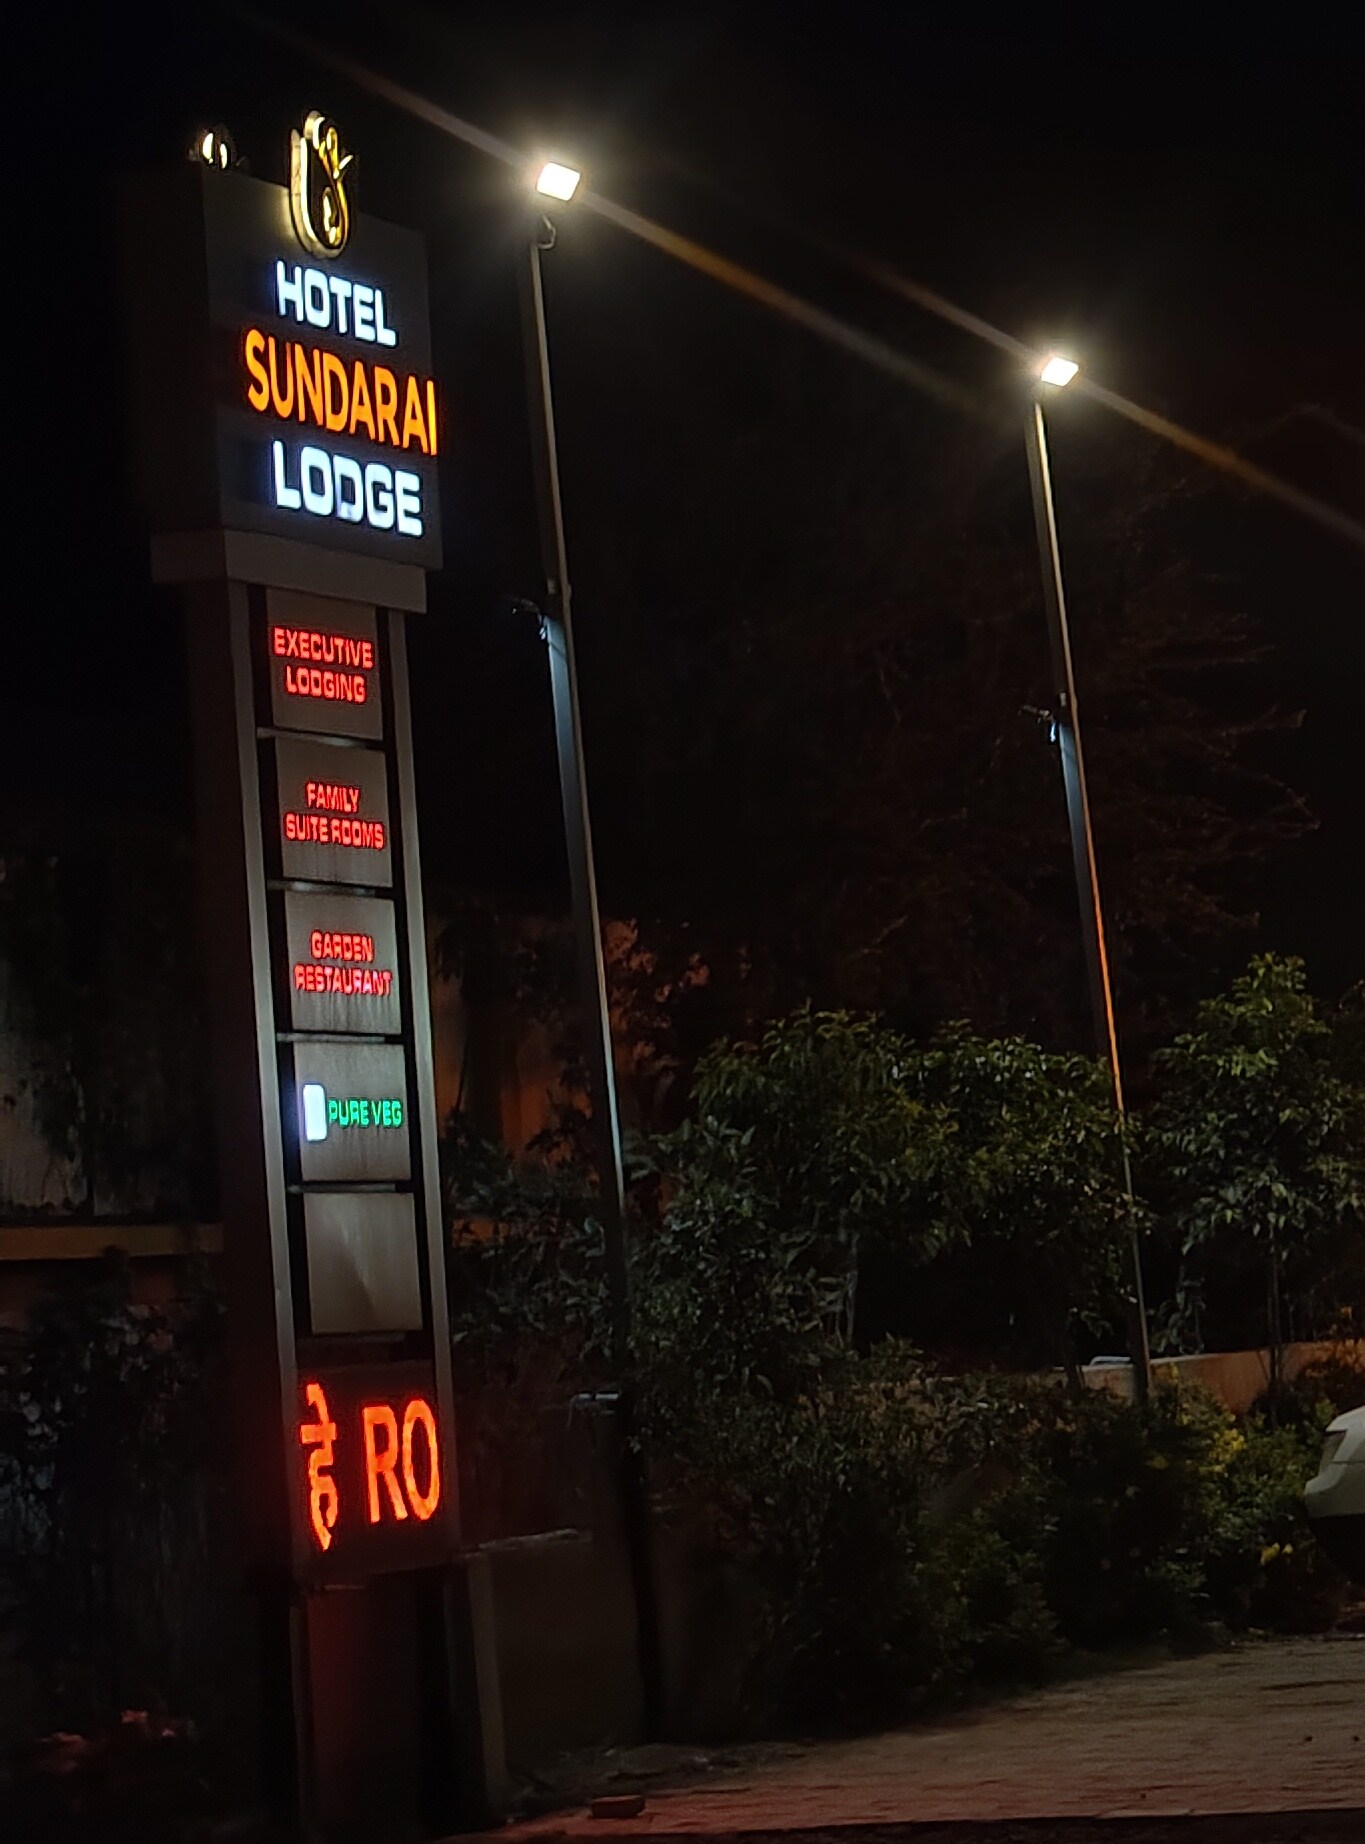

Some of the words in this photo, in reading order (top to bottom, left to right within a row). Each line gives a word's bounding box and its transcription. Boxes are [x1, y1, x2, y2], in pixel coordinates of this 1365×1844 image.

[276, 260, 396, 347] HOTEL
[245, 328, 438, 456] SUNDARAI
[273, 440, 423, 536] LODGE
[273, 627, 374, 668] EXECUTIVE
[285, 666, 366, 703] LODGING
[306, 781, 360, 813] FAMILY
[285, 813, 329, 843] SUITE
[330, 818, 384, 849] ROOMS
[311, 931, 374, 962] GARDEN
[294, 964, 392, 997] RESTAURANT
[328, 1099, 369, 1127] PURE
[370, 1100, 402, 1127] VEG
[362, 1398, 441, 1524] RO
